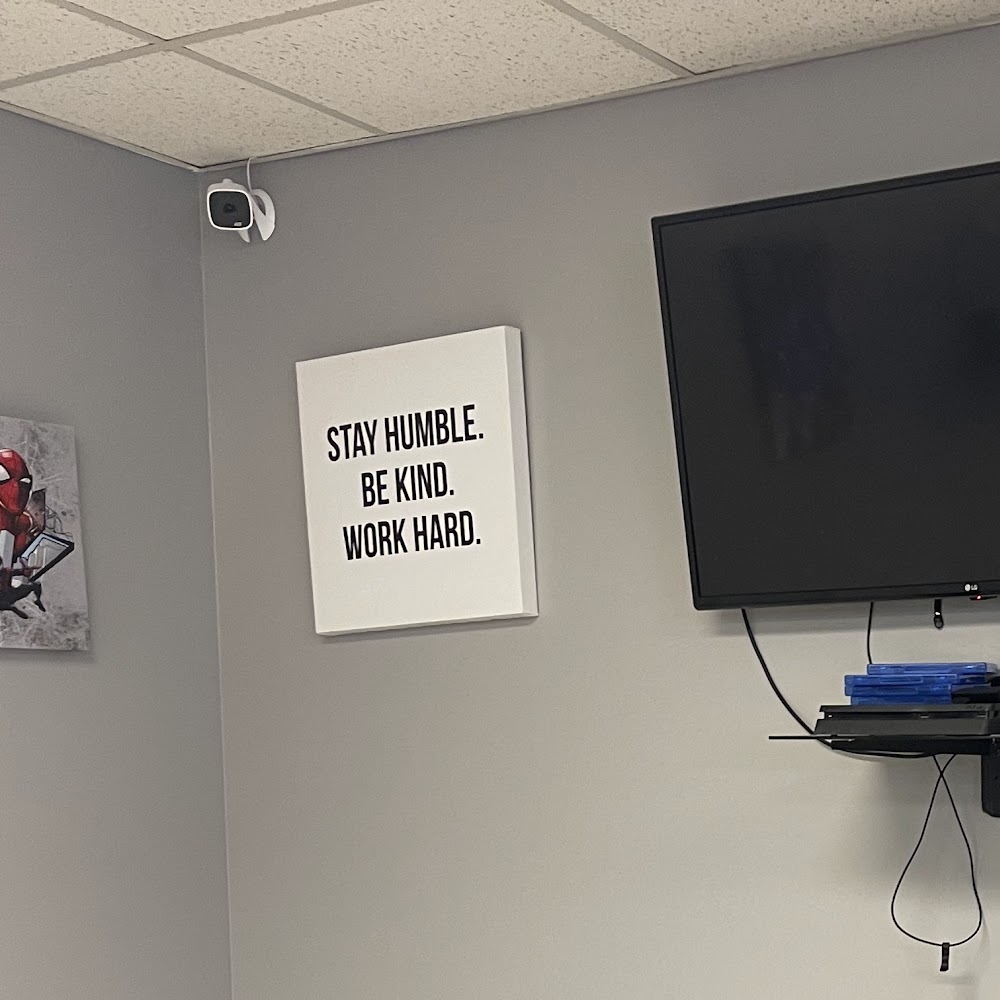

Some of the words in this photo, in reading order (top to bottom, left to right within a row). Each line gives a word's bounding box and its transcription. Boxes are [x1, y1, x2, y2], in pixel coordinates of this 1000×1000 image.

[327, 419, 378, 461] STAY
[384, 404, 484, 452] HUMBLE.
[361, 469, 390, 507] BE
[394, 461, 454, 503] KIND.
[343, 518, 408, 560] WORK
[413, 510, 481, 552] HARD.
